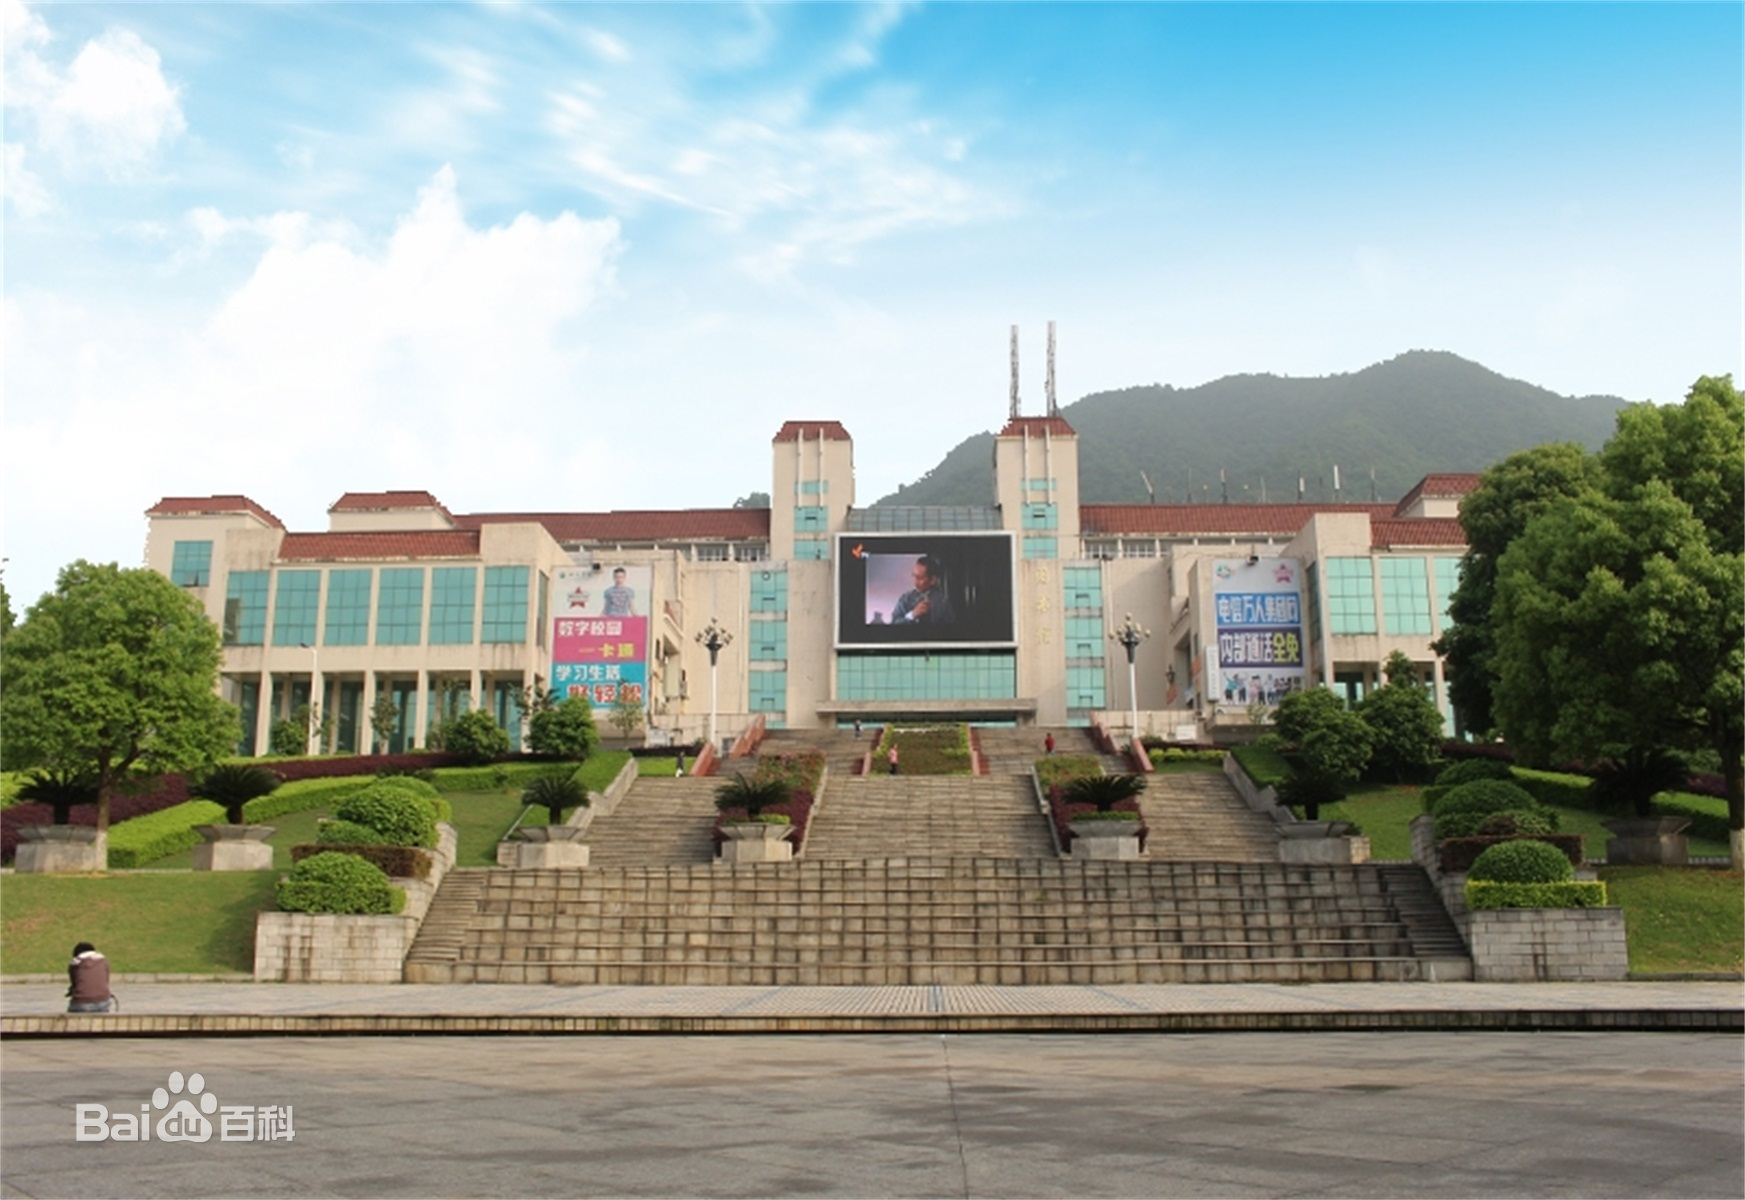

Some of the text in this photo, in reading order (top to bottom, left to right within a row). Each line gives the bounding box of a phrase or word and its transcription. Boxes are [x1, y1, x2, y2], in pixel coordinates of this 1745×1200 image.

[558, 620, 622, 636] 数字校园
[578, 643, 634, 658] 一卡通
[1219, 631, 1299, 663] 内部通话全免
[556, 664, 621, 681] 学习生活
